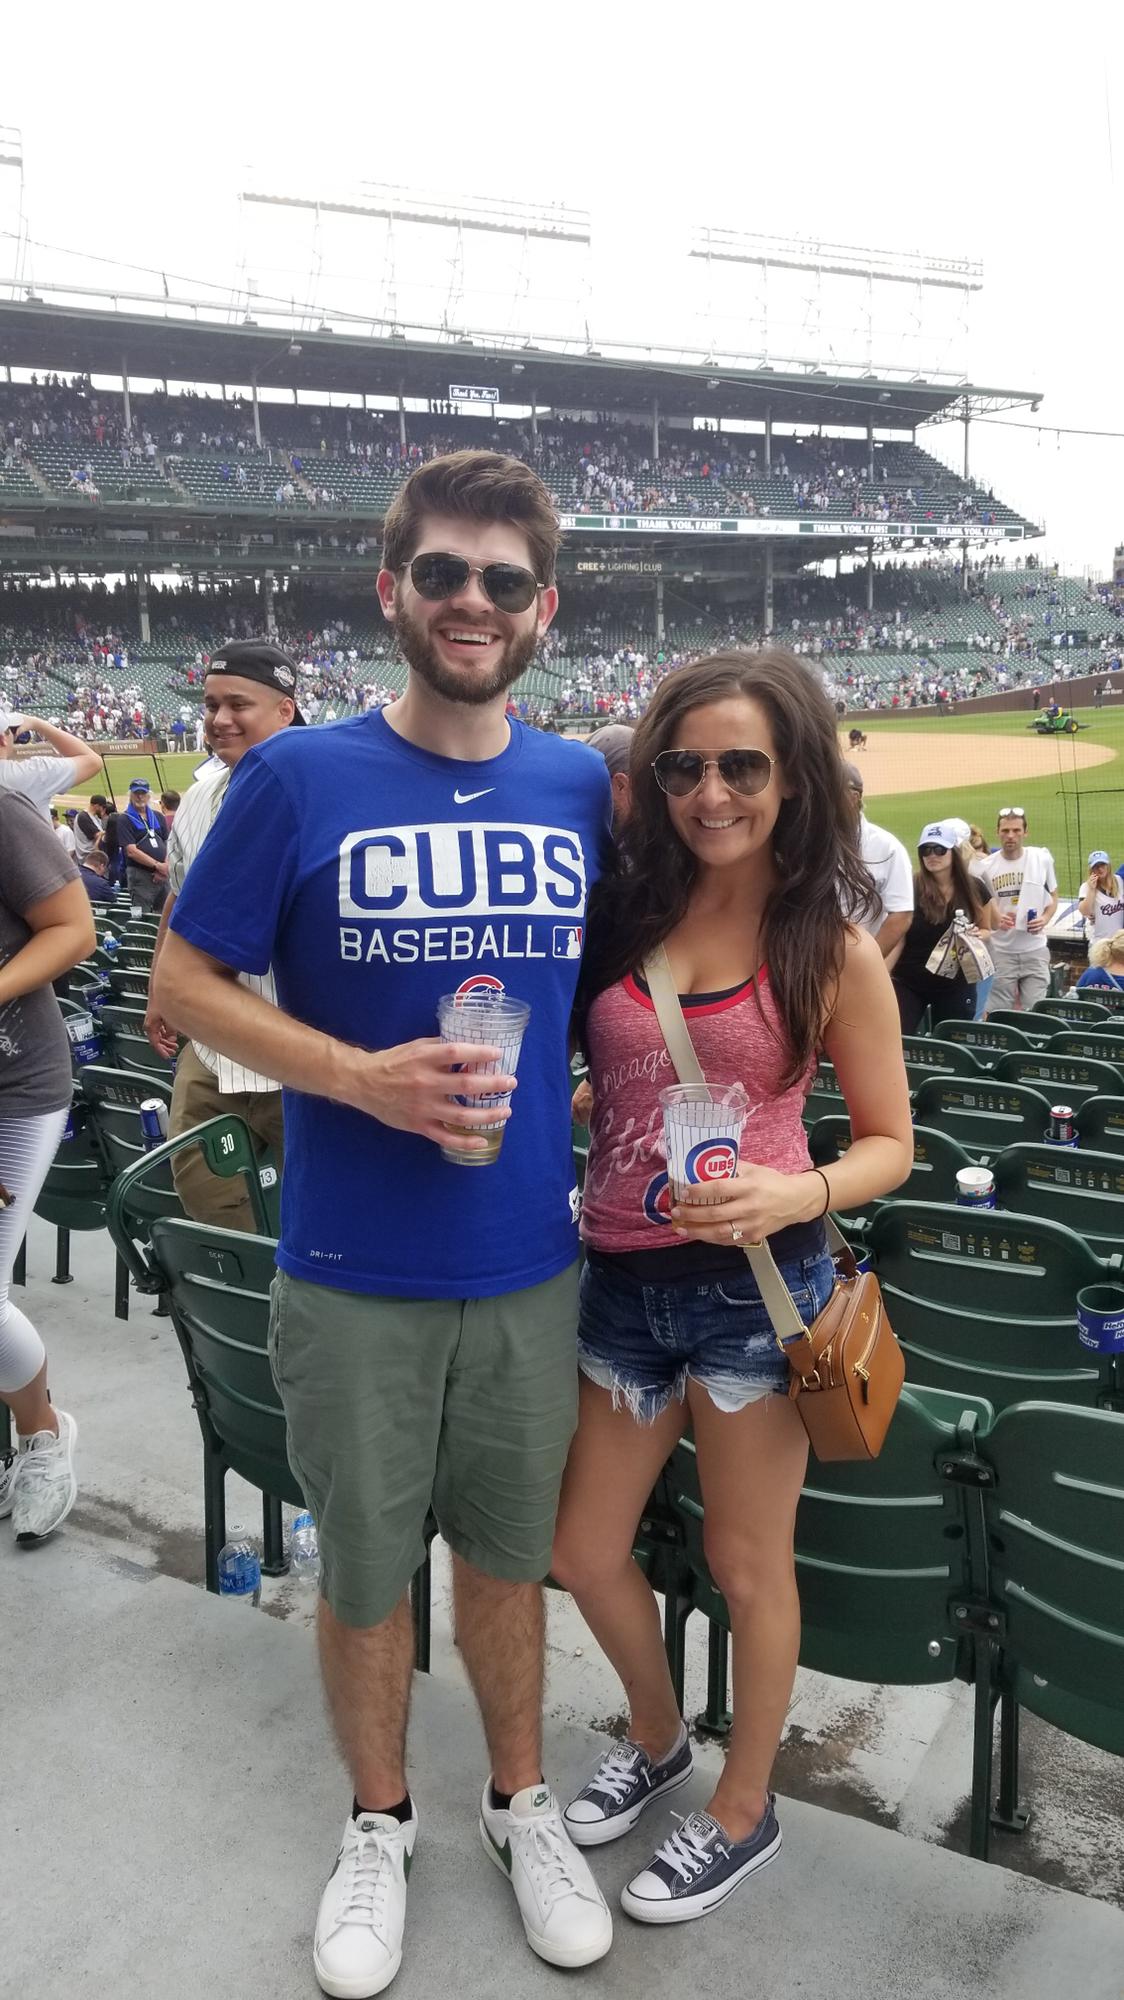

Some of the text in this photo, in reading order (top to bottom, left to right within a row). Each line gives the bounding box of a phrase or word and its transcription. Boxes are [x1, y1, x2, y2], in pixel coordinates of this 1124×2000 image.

[637, 519, 669, 529] THANK
[696, 521, 722, 530] FANS!
[813, 524, 842, 533] THANK
[865, 525, 888, 534] FANS!
[936, 527, 965, 535] THANK
[985, 527, 1006, 536] FANS!
[577, 562, 662, 571] CREE LIGHTING CLUB
[350, 830, 582, 911] CUBS
[339, 924, 546, 963] BASEBALL
[220, 1133, 235, 1155] 30
[309, 1249, 343, 1261] DRI-FIT
